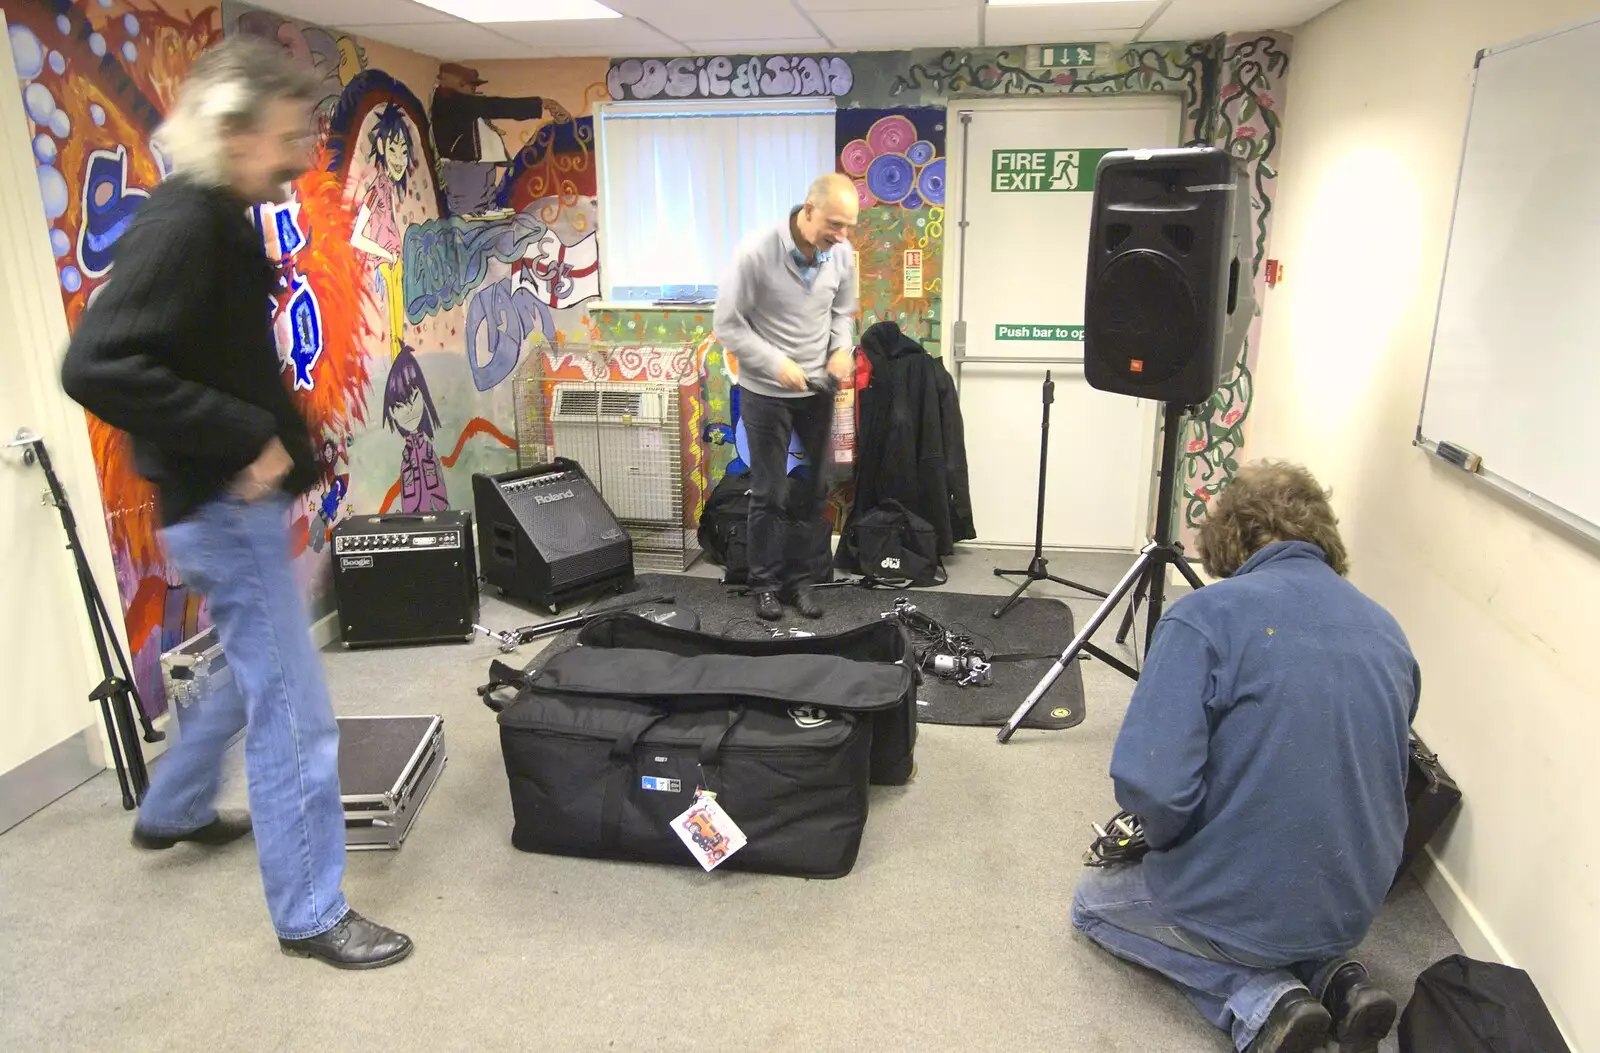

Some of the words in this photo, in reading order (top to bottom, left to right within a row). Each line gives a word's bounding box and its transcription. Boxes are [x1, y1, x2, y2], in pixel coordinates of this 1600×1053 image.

[997, 152, 1047, 170] FIRE
[995, 172, 1046, 190] EXIT
[999, 326, 1030, 337] Push
[1032, 327, 1053, 338] bar
[1055, 328, 1068, 338] to
[534, 489, 575, 505] Roland
[342, 557, 371, 567] Boogie
[880, 556, 900, 569] dw
